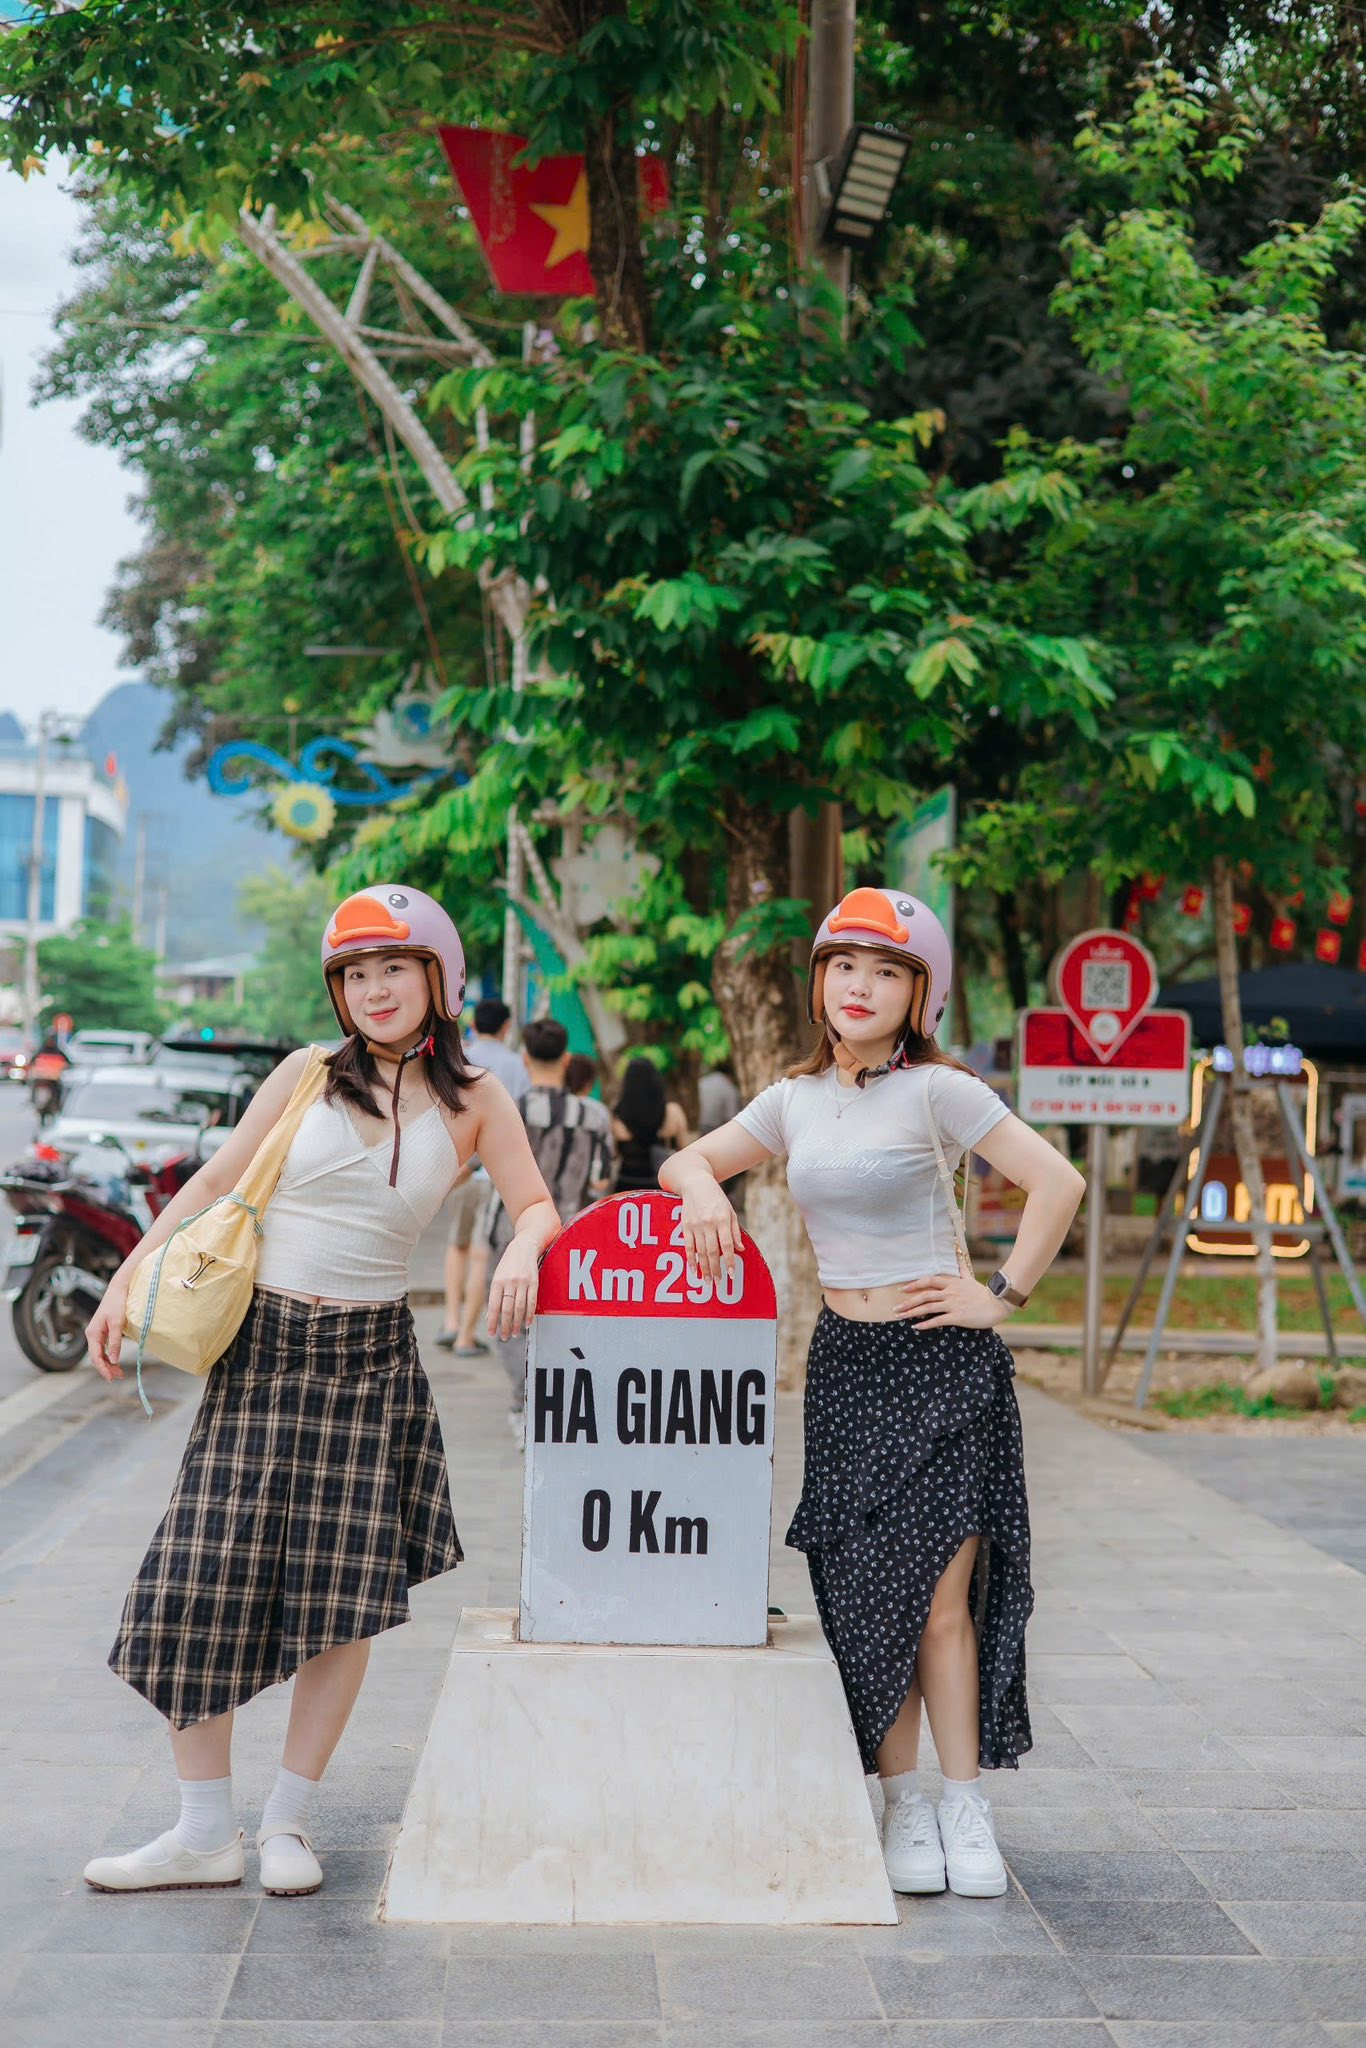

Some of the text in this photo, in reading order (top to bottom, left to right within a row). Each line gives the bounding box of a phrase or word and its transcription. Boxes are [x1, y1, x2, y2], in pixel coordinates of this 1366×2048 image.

[618, 1202, 658, 1249] QL
[568, 1249, 744, 1305] Km 290
[534, 1346, 766, 1446] HÀ GIANG
[582, 1489, 708, 1555] 0 Km
